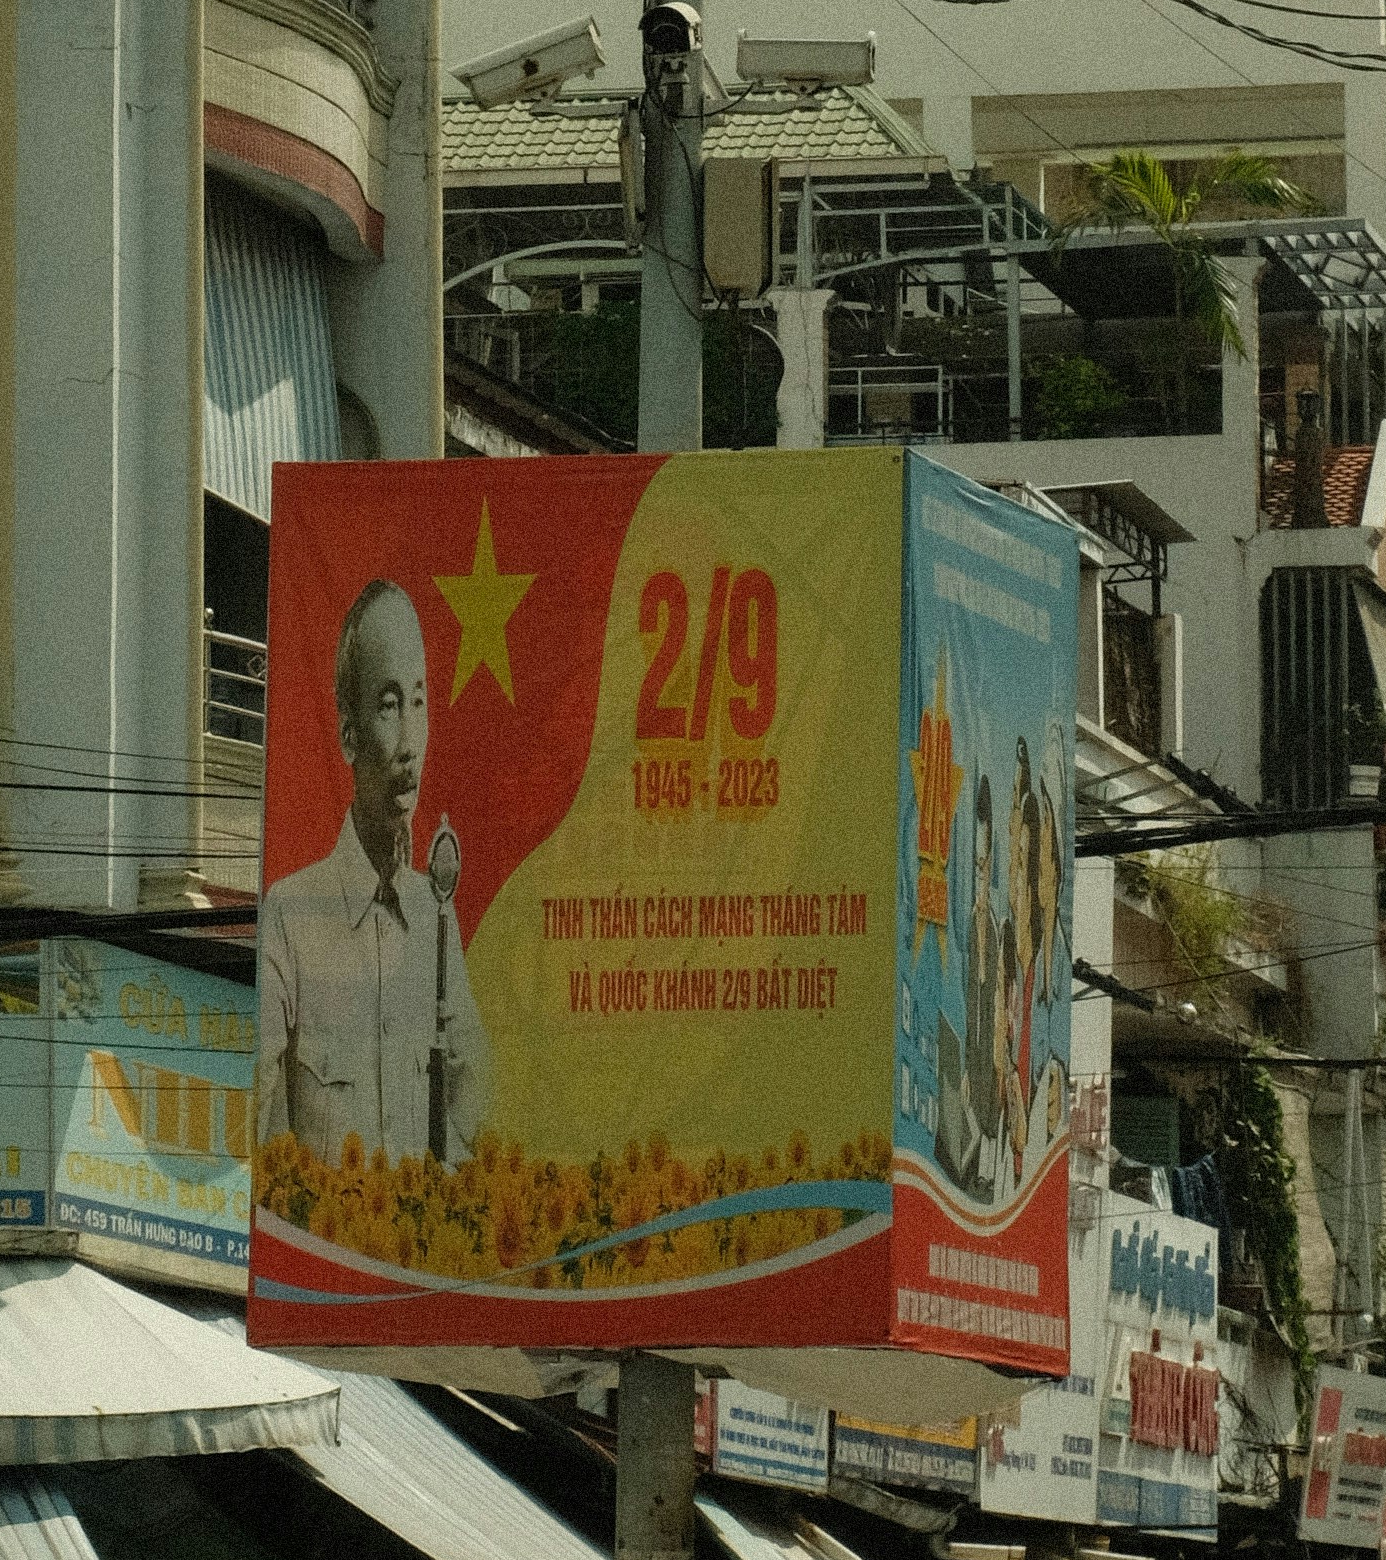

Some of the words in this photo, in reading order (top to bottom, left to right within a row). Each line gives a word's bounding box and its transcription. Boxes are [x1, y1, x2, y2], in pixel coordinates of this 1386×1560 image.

[635, 566, 779, 741] 2/9
[631, 759, 692, 809] 1945
[717, 757, 780, 807] 2023
[643, 888, 693, 938] CÁCH
[84, 1207, 108, 1231] 459
